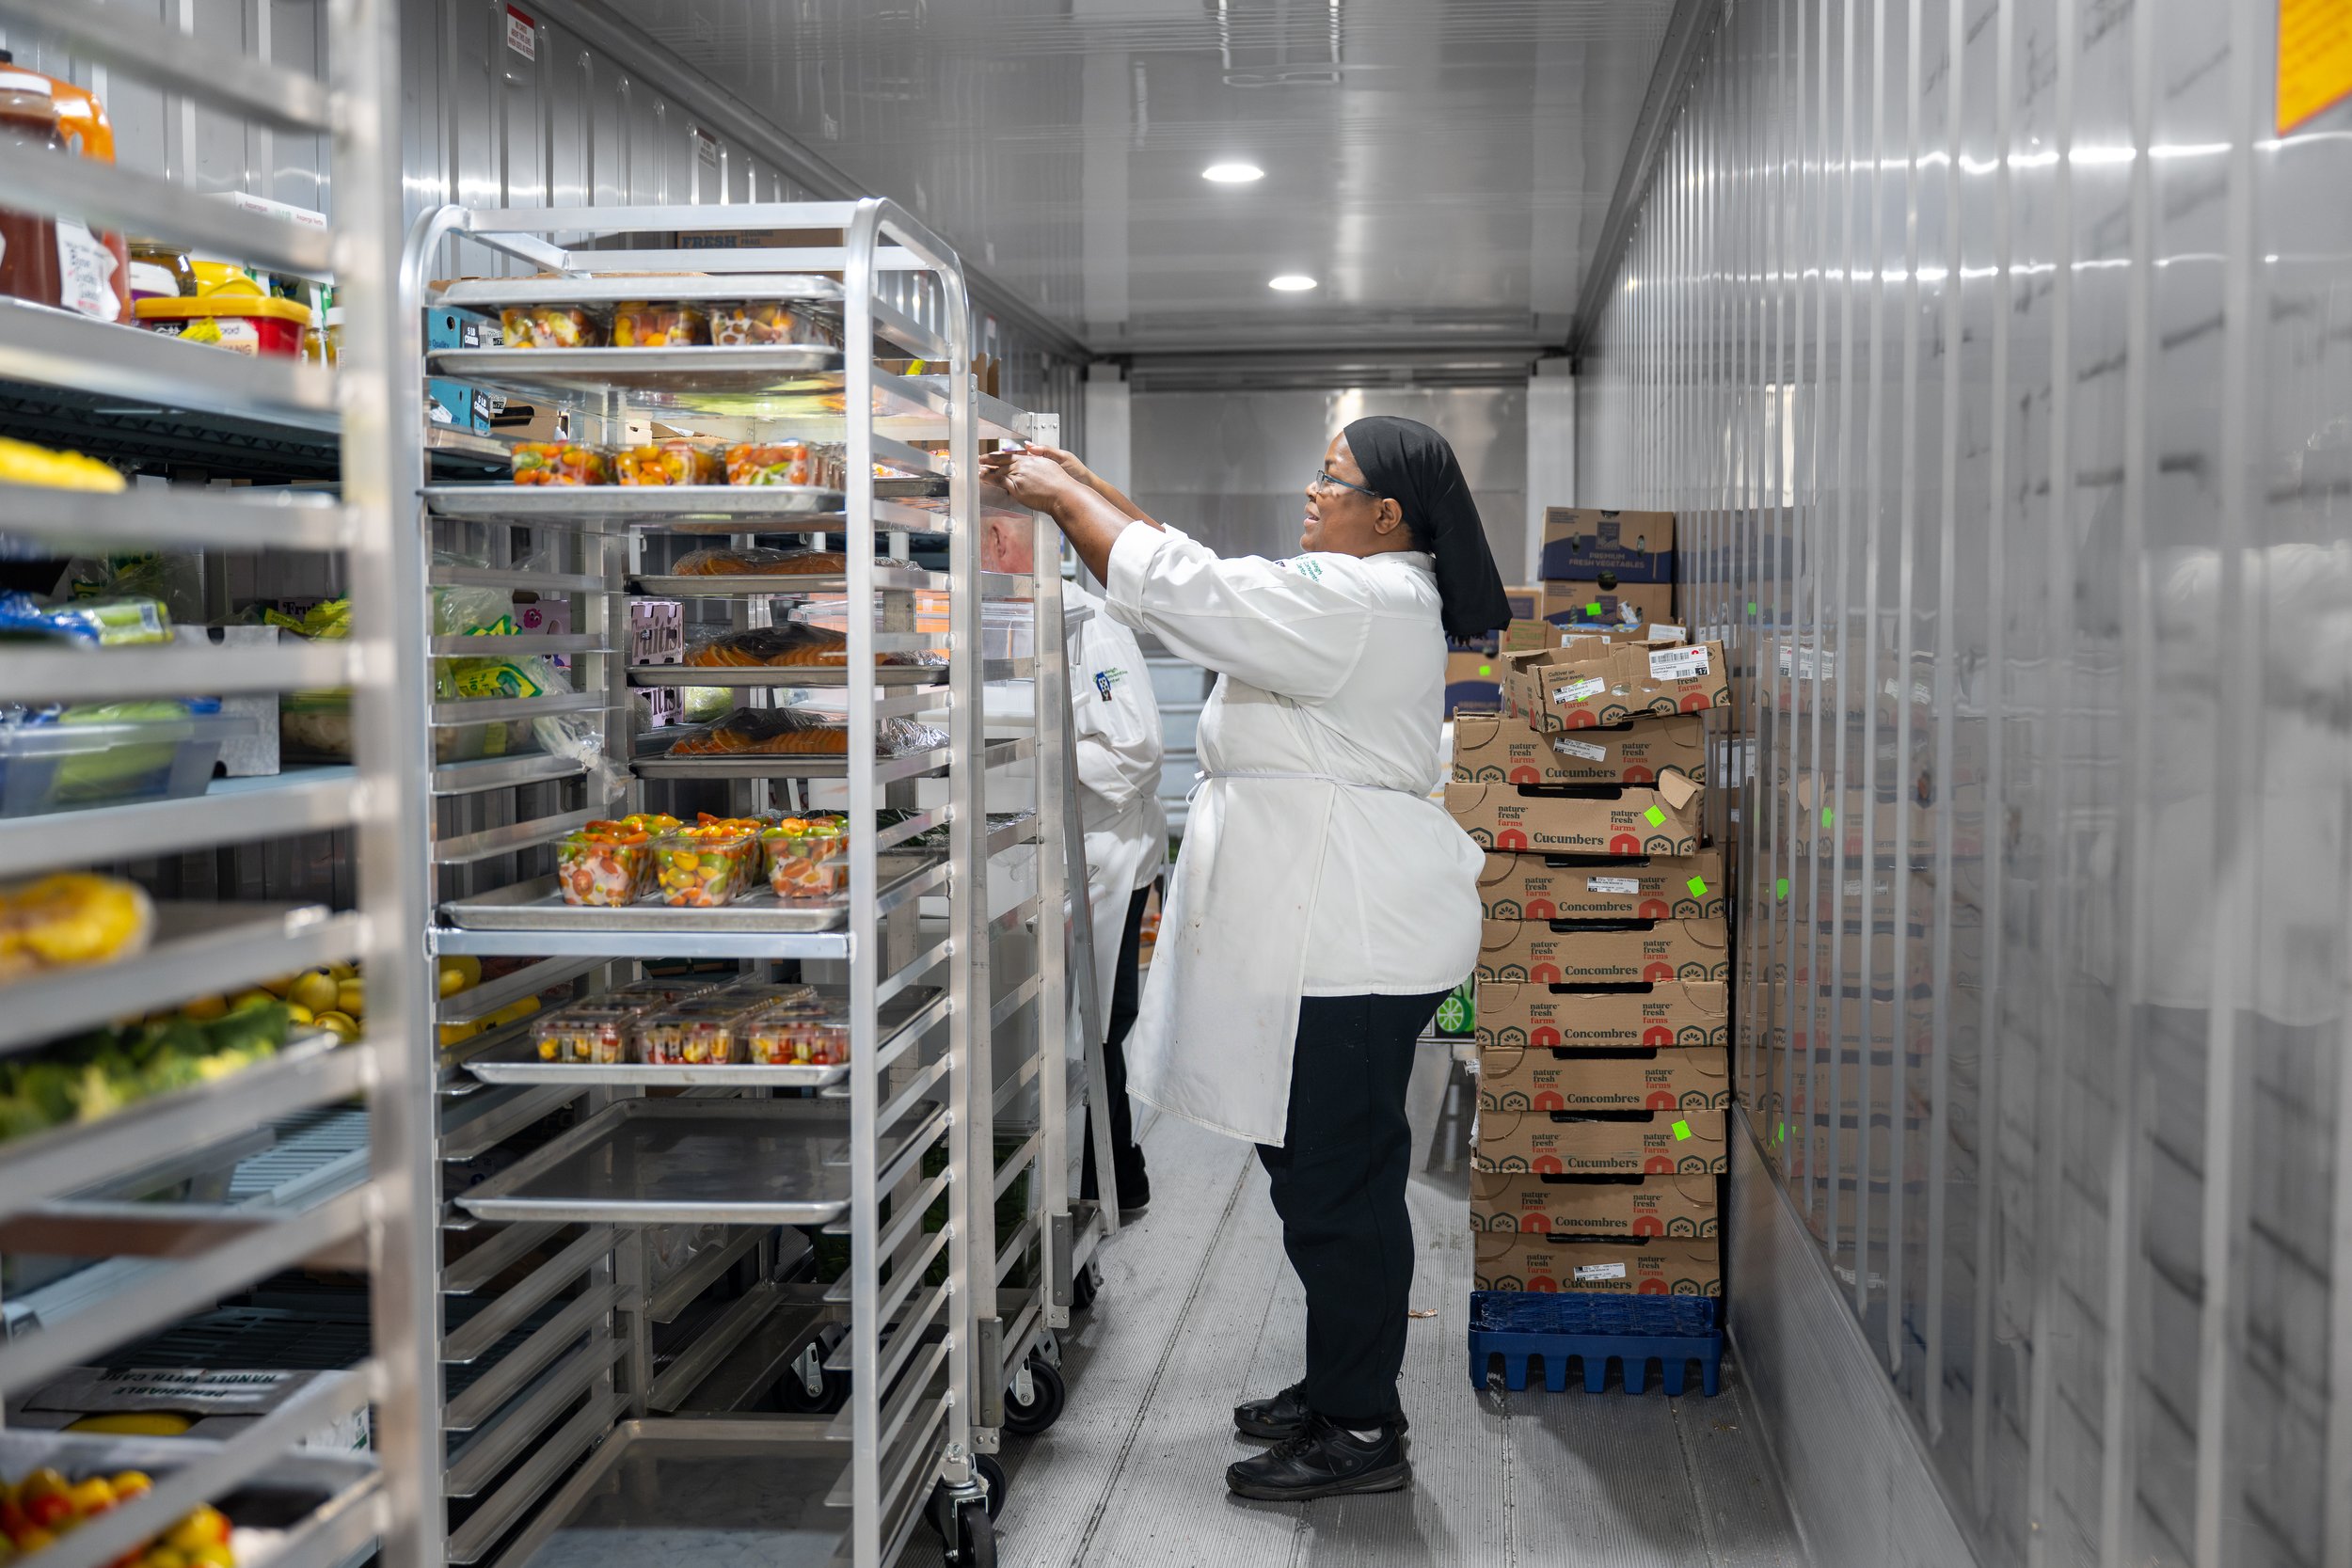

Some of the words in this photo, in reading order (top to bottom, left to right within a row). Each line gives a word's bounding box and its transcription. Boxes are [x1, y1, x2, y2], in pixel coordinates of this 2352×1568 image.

[682, 236, 738, 248] FRESH
[1596, 561, 1645, 569] VEGETABLES
[1677, 684, 1702, 692] farms
[1546, 768, 1615, 778] Cucumbers
[1534, 832, 1603, 845] Cucumbers
[1559, 902, 1632, 912] Concombres
[1565, 965, 1638, 976] Concombres
[1643, 1016, 1668, 1024] farms
[1565, 1029, 1637, 1039] Concombres
[1567, 1094, 1640, 1104] Concombres
[1568, 1158, 1638, 1169] Cucumbers
[1555, 1216, 1628, 1228] Concombres
[1563, 1278, 1631, 1290] Cucumbers
[152, 1374, 199, 1383] WITH
[203, 1373, 277, 1383] HANDLE
